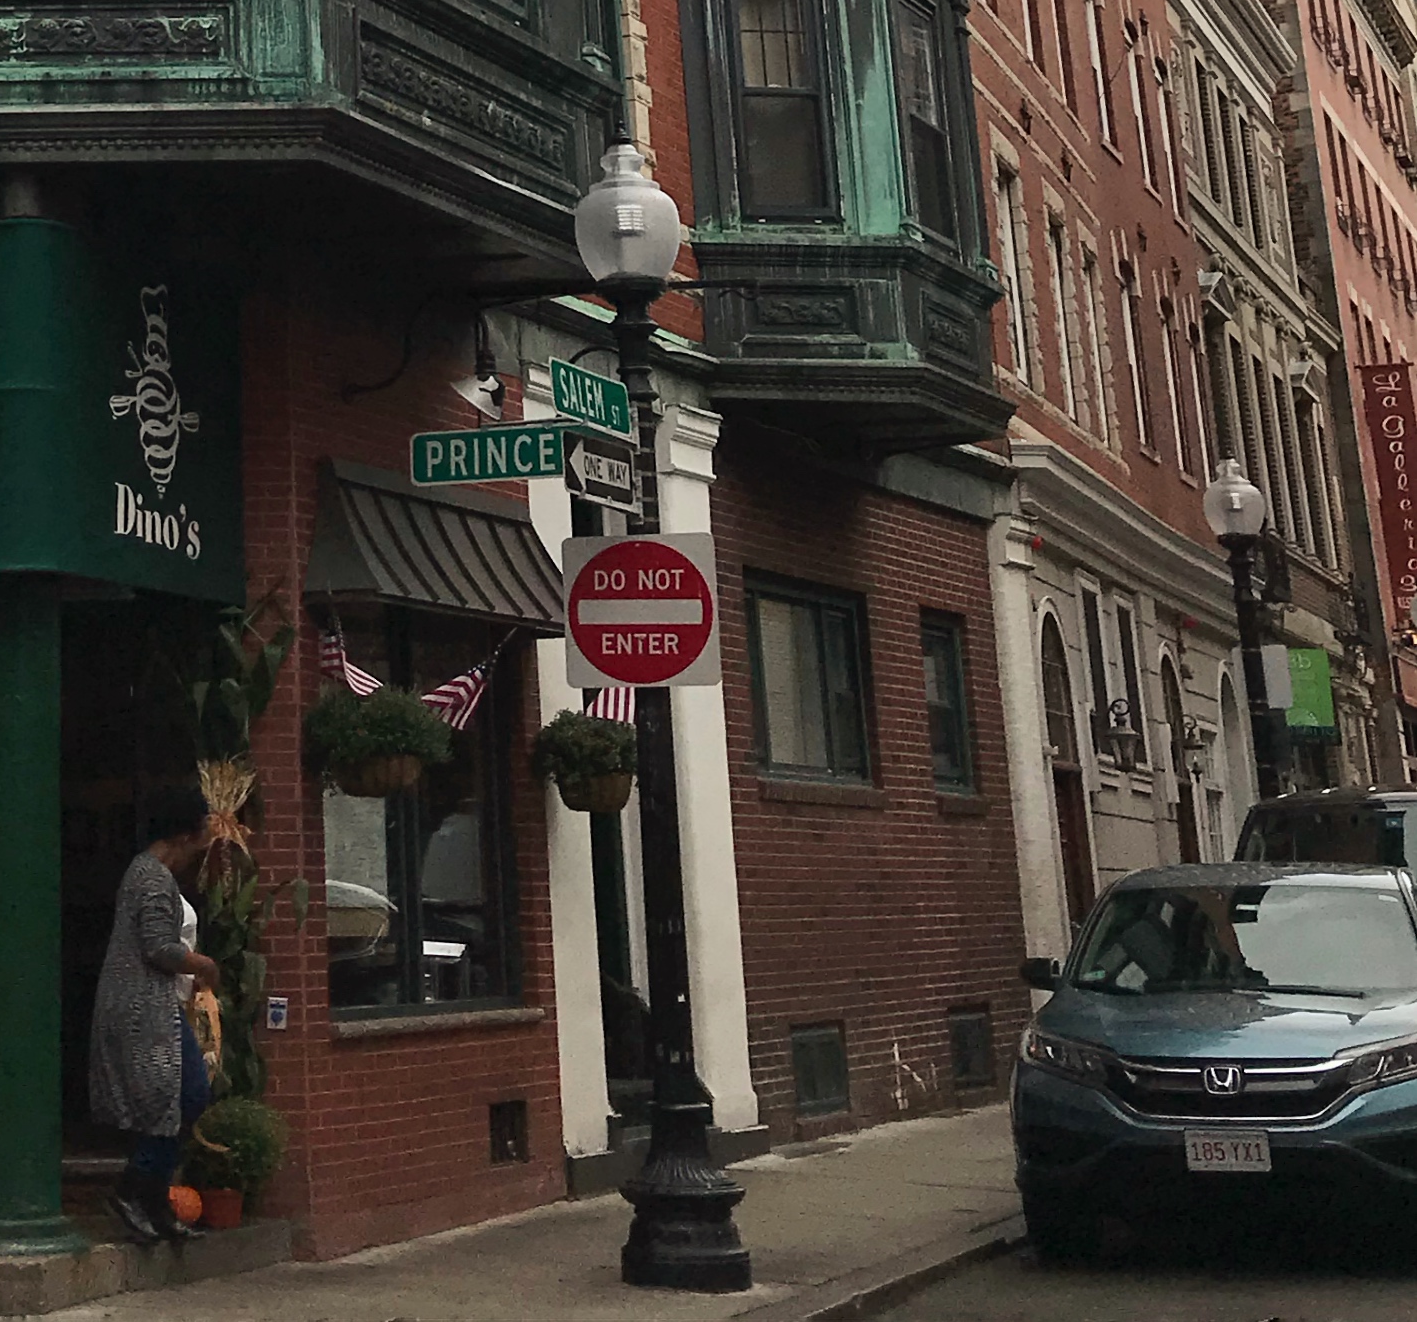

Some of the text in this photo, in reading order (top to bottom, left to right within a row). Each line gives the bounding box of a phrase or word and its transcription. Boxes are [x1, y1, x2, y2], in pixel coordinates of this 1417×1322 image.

[559, 367, 621, 428] SALEM ST
[426, 433, 557, 478] PRINCE
[583, 454, 628, 489] ONE WAY
[114, 482, 201, 560] Dino's
[594, 569, 684, 591] DO NOT
[601, 633, 680, 655] ENTER
[1191, 1141, 1267, 1162] 185 YX1
